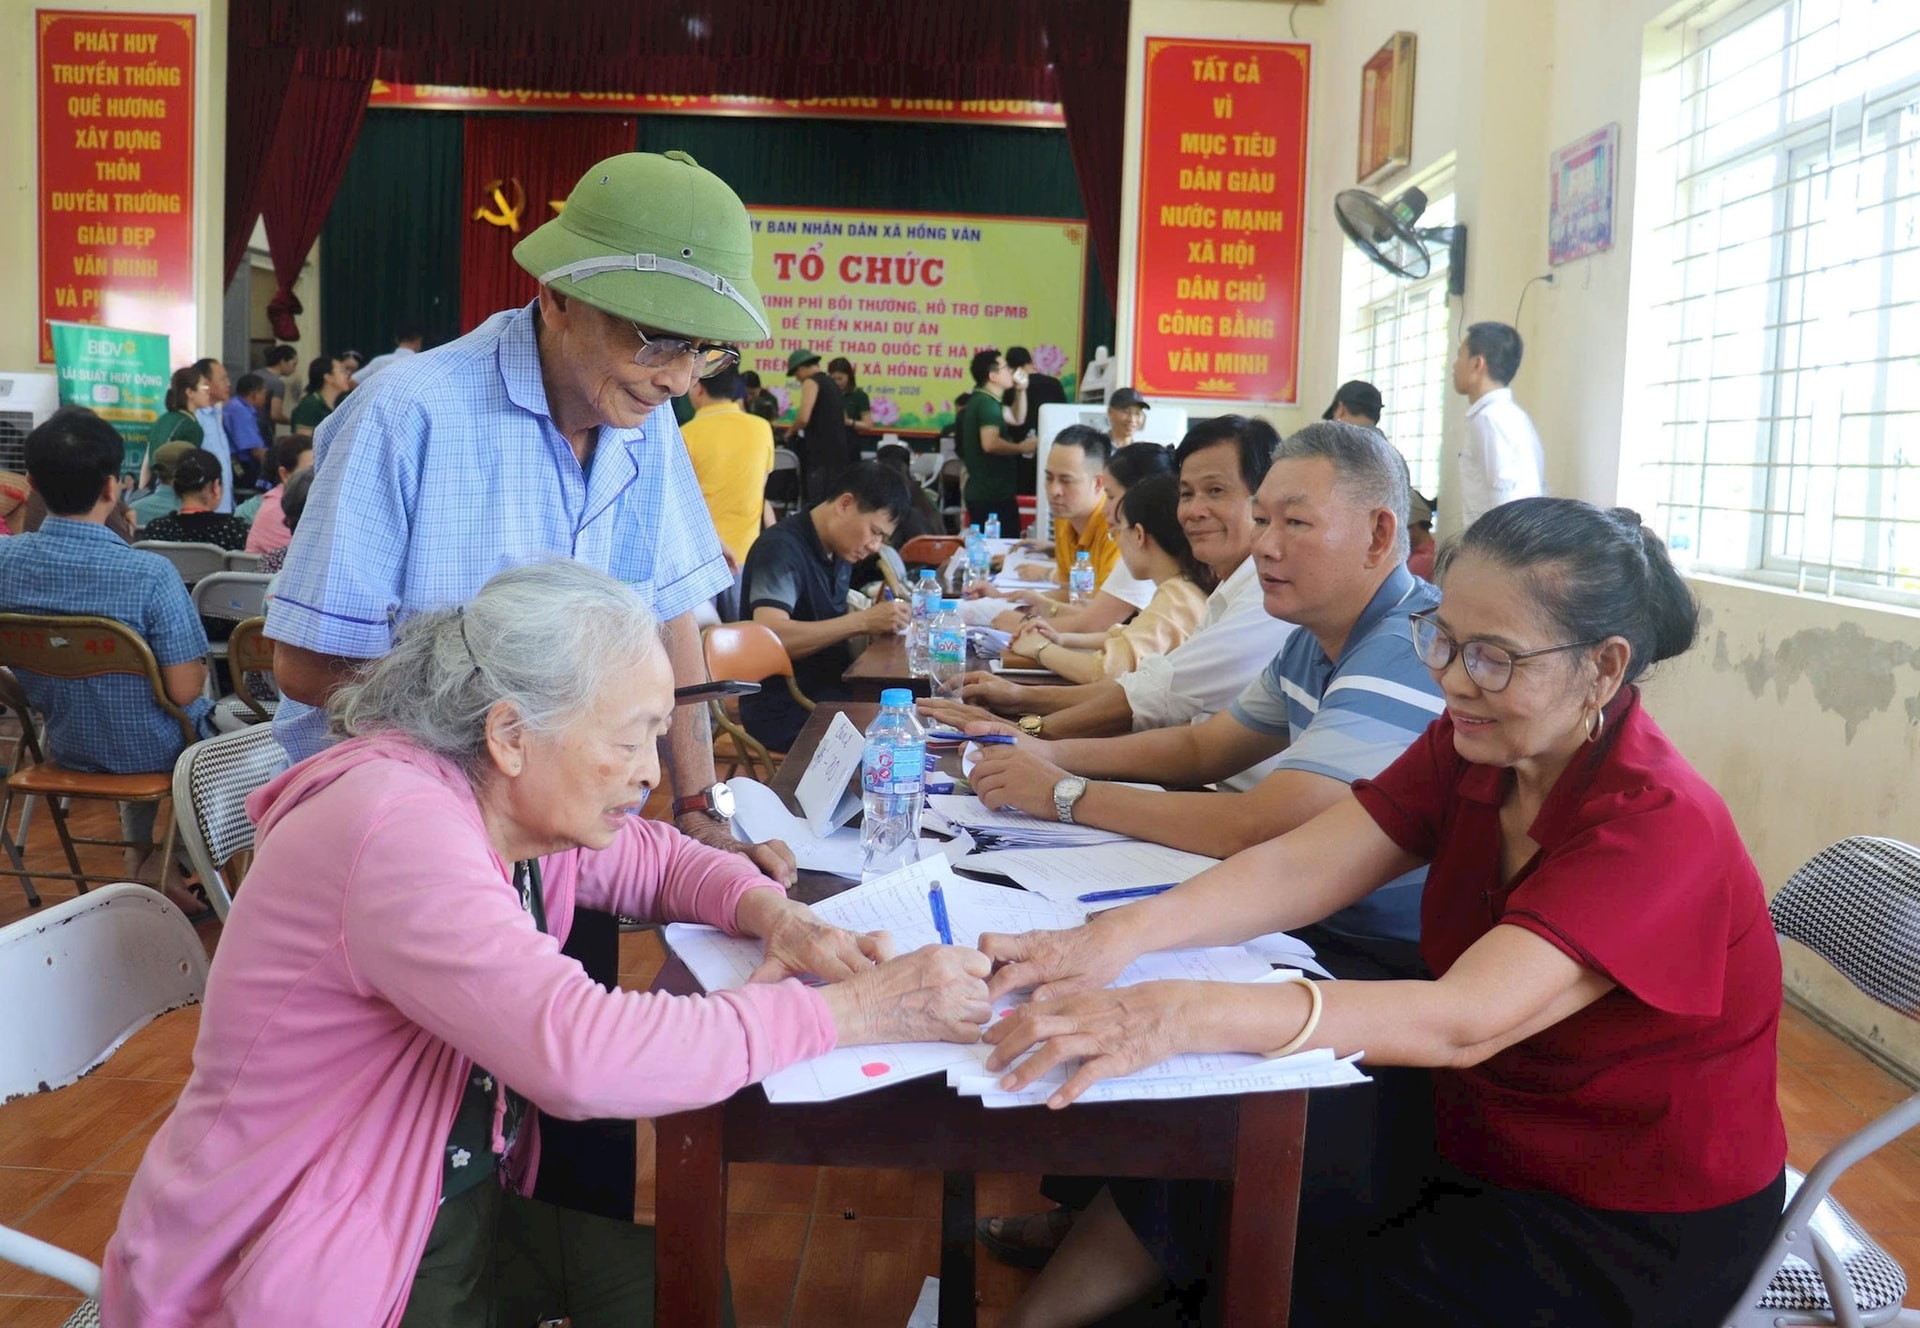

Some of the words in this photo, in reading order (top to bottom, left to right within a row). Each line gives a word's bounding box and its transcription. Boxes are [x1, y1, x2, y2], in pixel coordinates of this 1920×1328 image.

[74, 28, 119, 52] PHÁT
[124, 33, 158, 53] HUY
[124, 60, 181, 86] THỐNG
[1192, 55, 1228, 82] TẤT
[1233, 55, 1261, 84] CẢ
[68, 93, 101, 118] QUÊ
[107, 96, 166, 118] HƯƠNG
[1213, 93, 1233, 118] VÌ
[76, 125, 108, 149] XÂY
[114, 129, 161, 154] DỰNG
[1180, 132, 1227, 159] MỤC
[1232, 131, 1277, 158] TIÊU
[96, 157, 141, 181] THÔN
[1179, 165, 1222, 191] DÂN
[1227, 168, 1275, 193] GIÀU
[52, 188, 108, 212] DUYÊN
[767, 221, 797, 234] BAN
[802, 220, 842, 236] NHÂN
[848, 222, 877, 237] DÂN
[883, 223, 902, 238] XÃ
[952, 227, 981, 241] VÂN
[1160, 202, 1216, 229] NƯỚC
[1222, 208, 1283, 235] MẠNH
[77, 222, 117, 245] GIÀU
[122, 226, 155, 250] ĐẸP
[74, 253, 107, 276] VĂN
[113, 258, 158, 277] MINH
[774, 242, 824, 282] TỔ
[839, 251, 944, 287] CHỨC
[1188, 239, 1215, 264] XÃ
[1221, 239, 1255, 269] HỘI
[56, 284, 78, 307] VÀ
[1177, 274, 1219, 300] DÂN
[1225, 274, 1266, 303] CHỦ
[984, 305, 1028, 319] GPMB
[1158, 308, 1213, 336] CÔNG
[1219, 309, 1274, 339] BẰNG
[853, 319, 887, 333] KHAI
[894, 321, 913, 336] DỰ
[88, 339, 123, 357] BIDV
[839, 341, 876, 354] THAO
[882, 341, 921, 356] QUỐC
[948, 344, 967, 358] HÀ
[863, 361, 881, 375] XÃ
[934, 365, 963, 379] VÂN
[1168, 347, 1209, 373] VĂN
[1214, 353, 1269, 375] MINH
[110, 372, 131, 385] HUY
